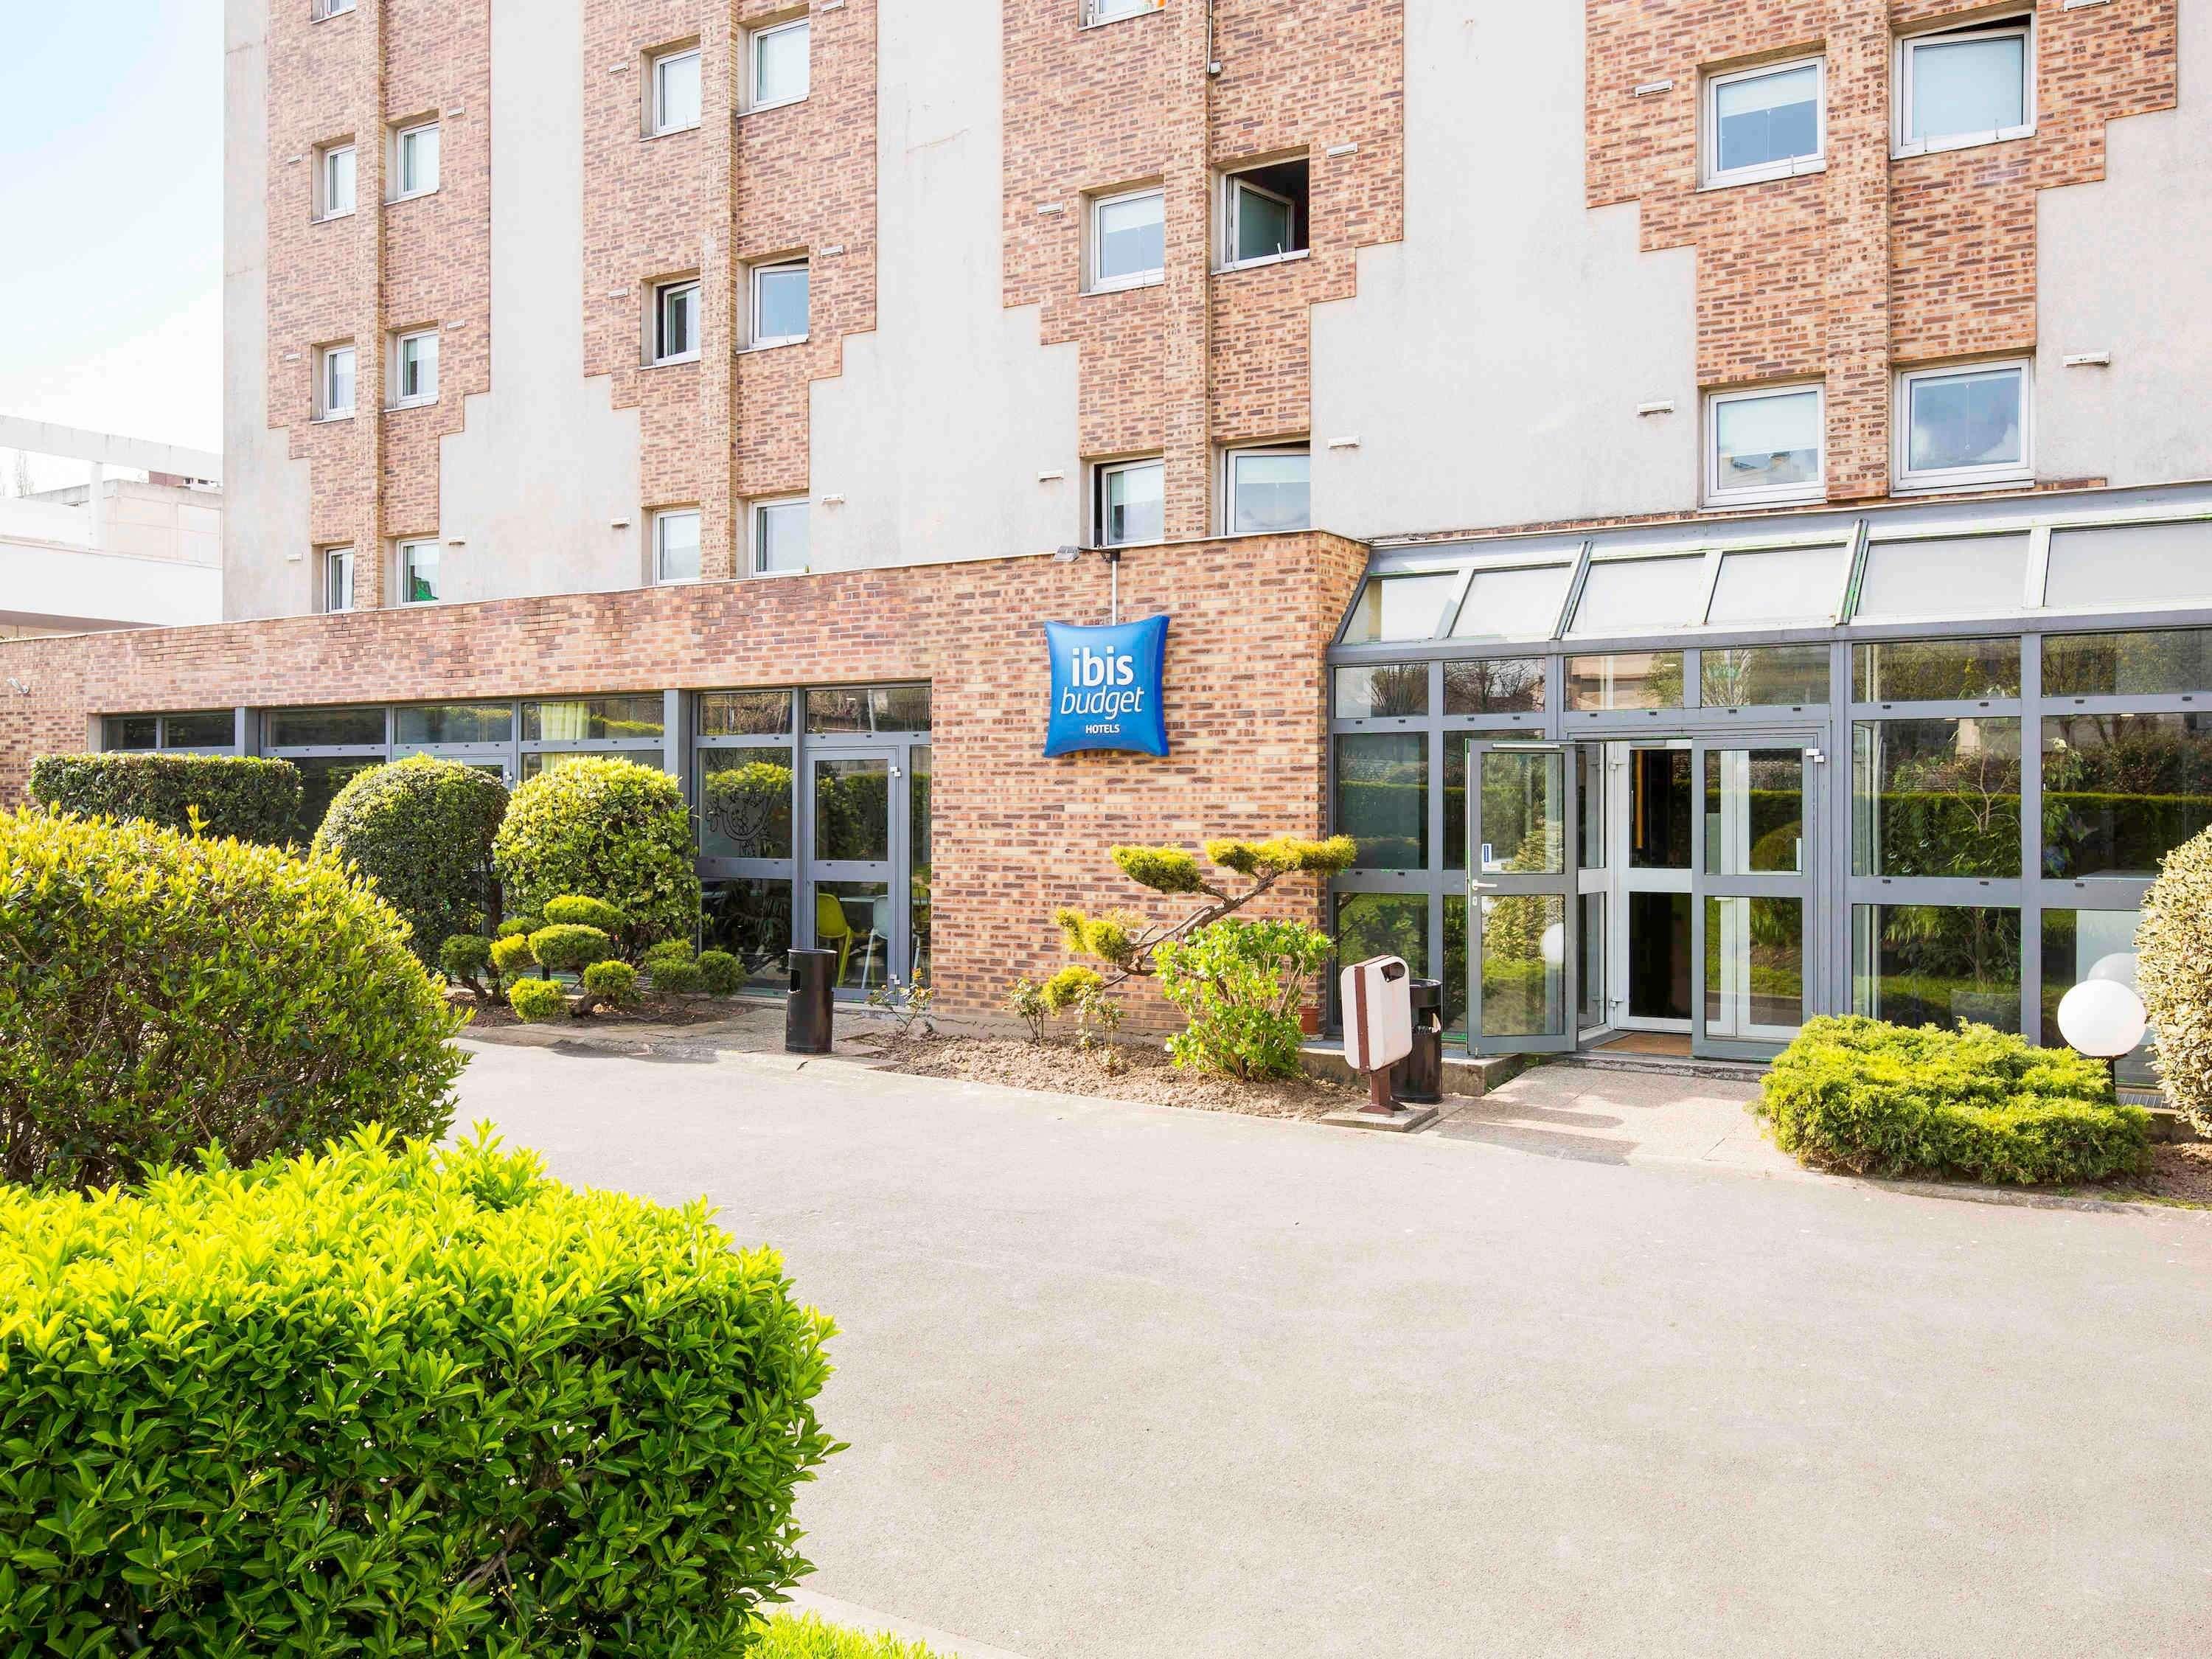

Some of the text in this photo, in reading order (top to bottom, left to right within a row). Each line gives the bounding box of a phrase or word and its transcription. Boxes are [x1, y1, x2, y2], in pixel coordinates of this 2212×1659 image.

[1071, 646, 1134, 687] ibis
[1060, 686, 1145, 720] budget
[1085, 723, 1120, 734] HOTELS
